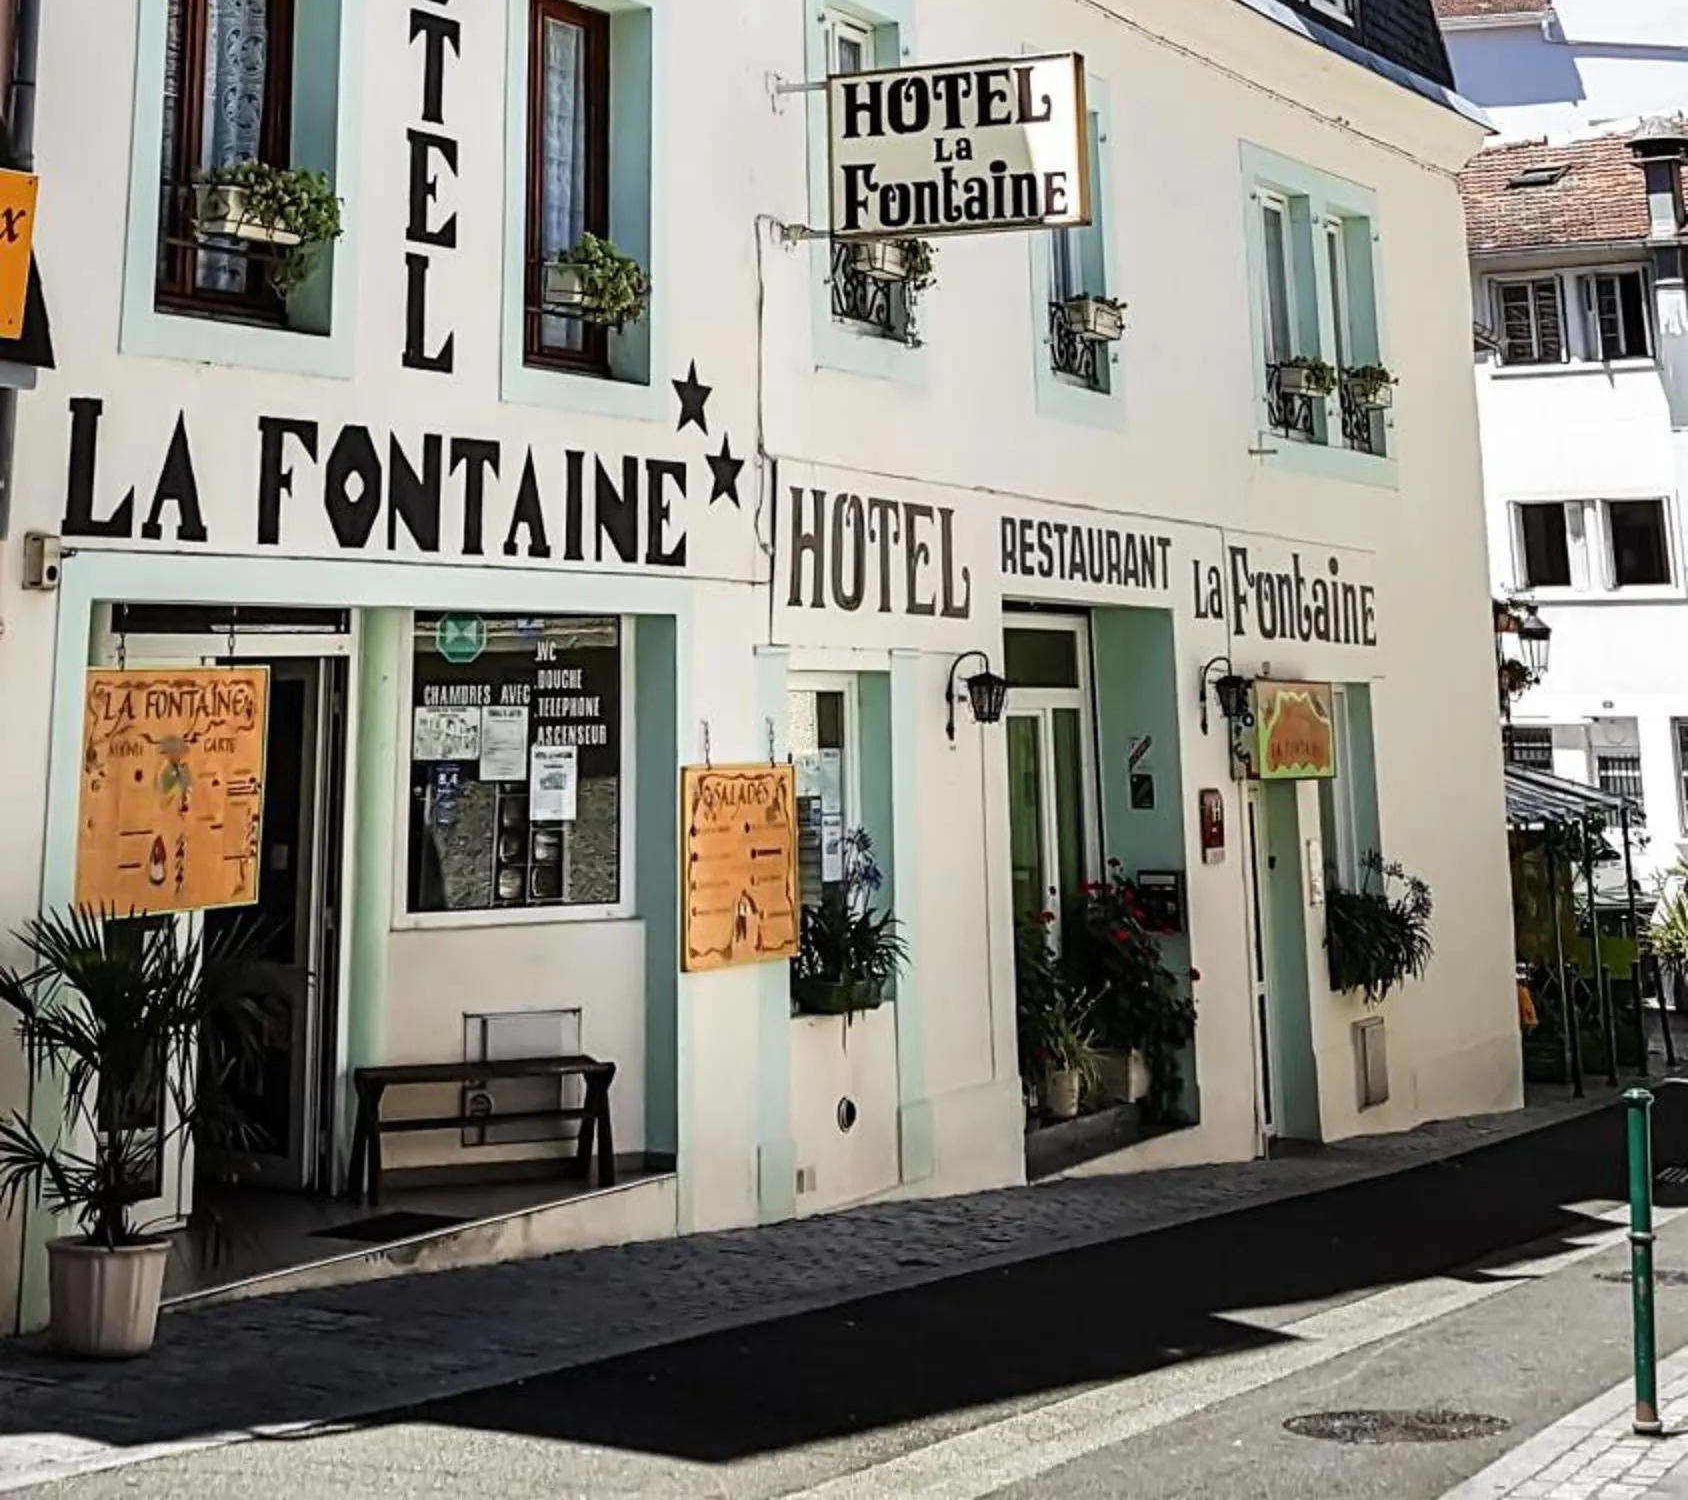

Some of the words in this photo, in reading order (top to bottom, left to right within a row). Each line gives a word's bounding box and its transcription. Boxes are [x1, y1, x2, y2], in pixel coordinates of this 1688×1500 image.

[842, 66, 1051, 138] HOTEL
[933, 137, 973, 163] La
[61, 397, 208, 542] LA
[257, 415, 688, 567] FONTAINE
[787, 487, 970, 620] HOTEL
[1001, 516, 1171, 591] RESTAURANT
[1193, 559, 1223, 621] La
[104, 690, 136, 721] LA
[145, 683, 245, 720] FONTAINE
[423, 685, 491, 705] CHAMBRES
[500, 685, 531, 704] AVEC
[536, 725, 607, 745] ASCENSEUR
